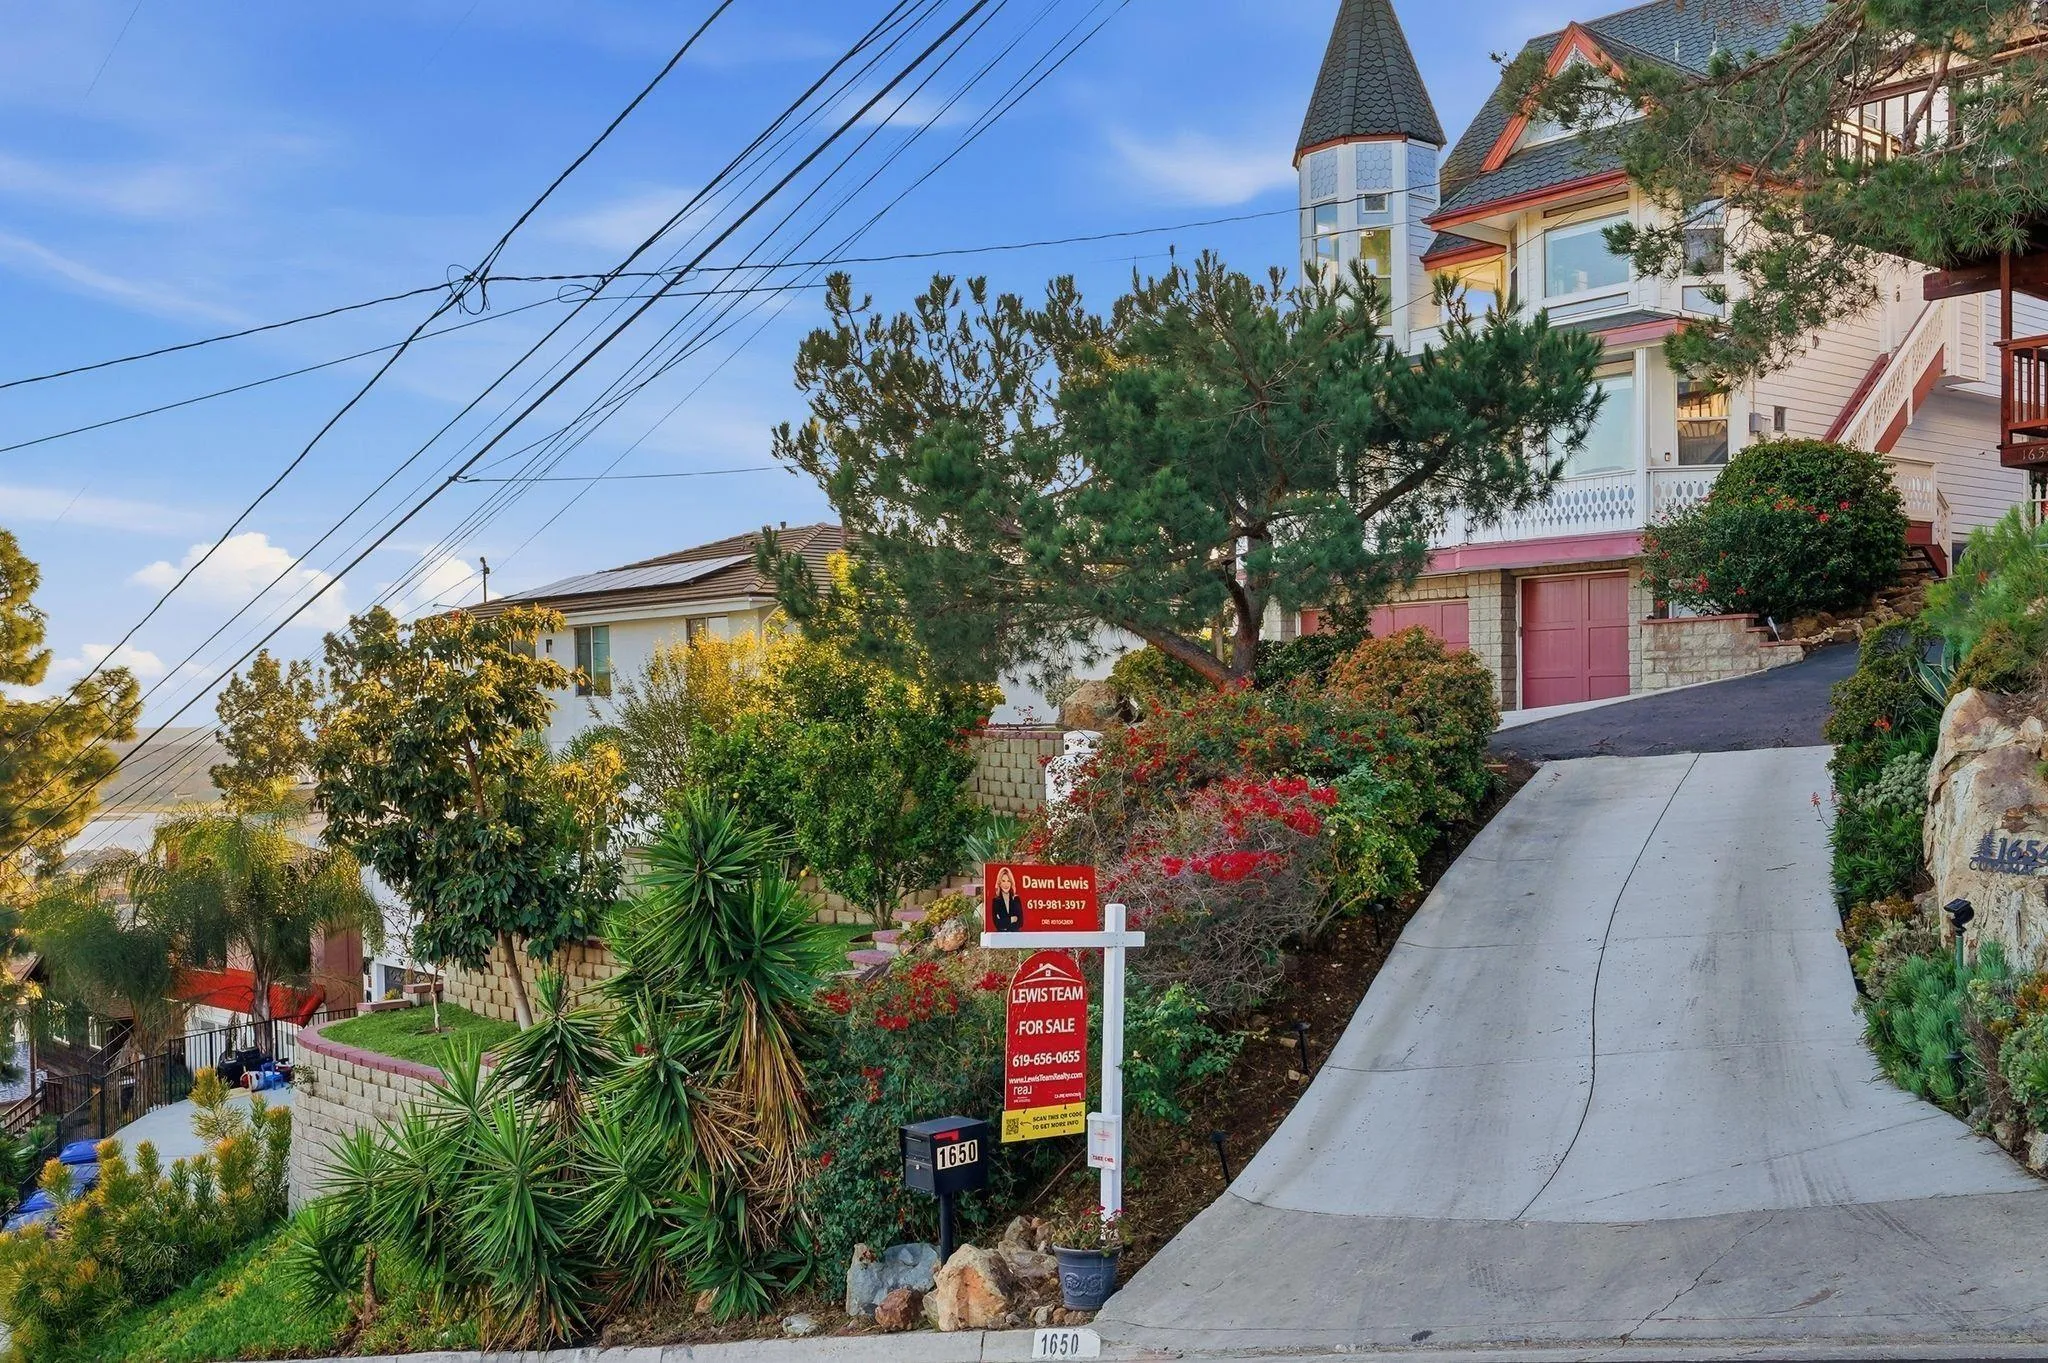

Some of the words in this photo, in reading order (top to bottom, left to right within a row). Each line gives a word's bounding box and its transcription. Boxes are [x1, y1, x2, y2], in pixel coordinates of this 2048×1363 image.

[2022, 447, 2048, 460] 165
[1022, 875, 1055, 889] Dawn
[1058, 876, 1089, 890] Lewis
[1027, 899, 1086, 910] 619-981-3917
[1012, 987, 1048, 1004] LEWIS
[1049, 986, 1083, 1002] TEAM
[1019, 1020, 1043, 1035] FOR
[1046, 1018, 1075, 1033] SALE
[1012, 1050, 1080, 1067] 619-656-0655
[1009, 1072, 1083, 1084] www.LewisTeamRealty.com
[940, 1141, 976, 1167] 1650
[1041, 1333, 1079, 1355] 1650
